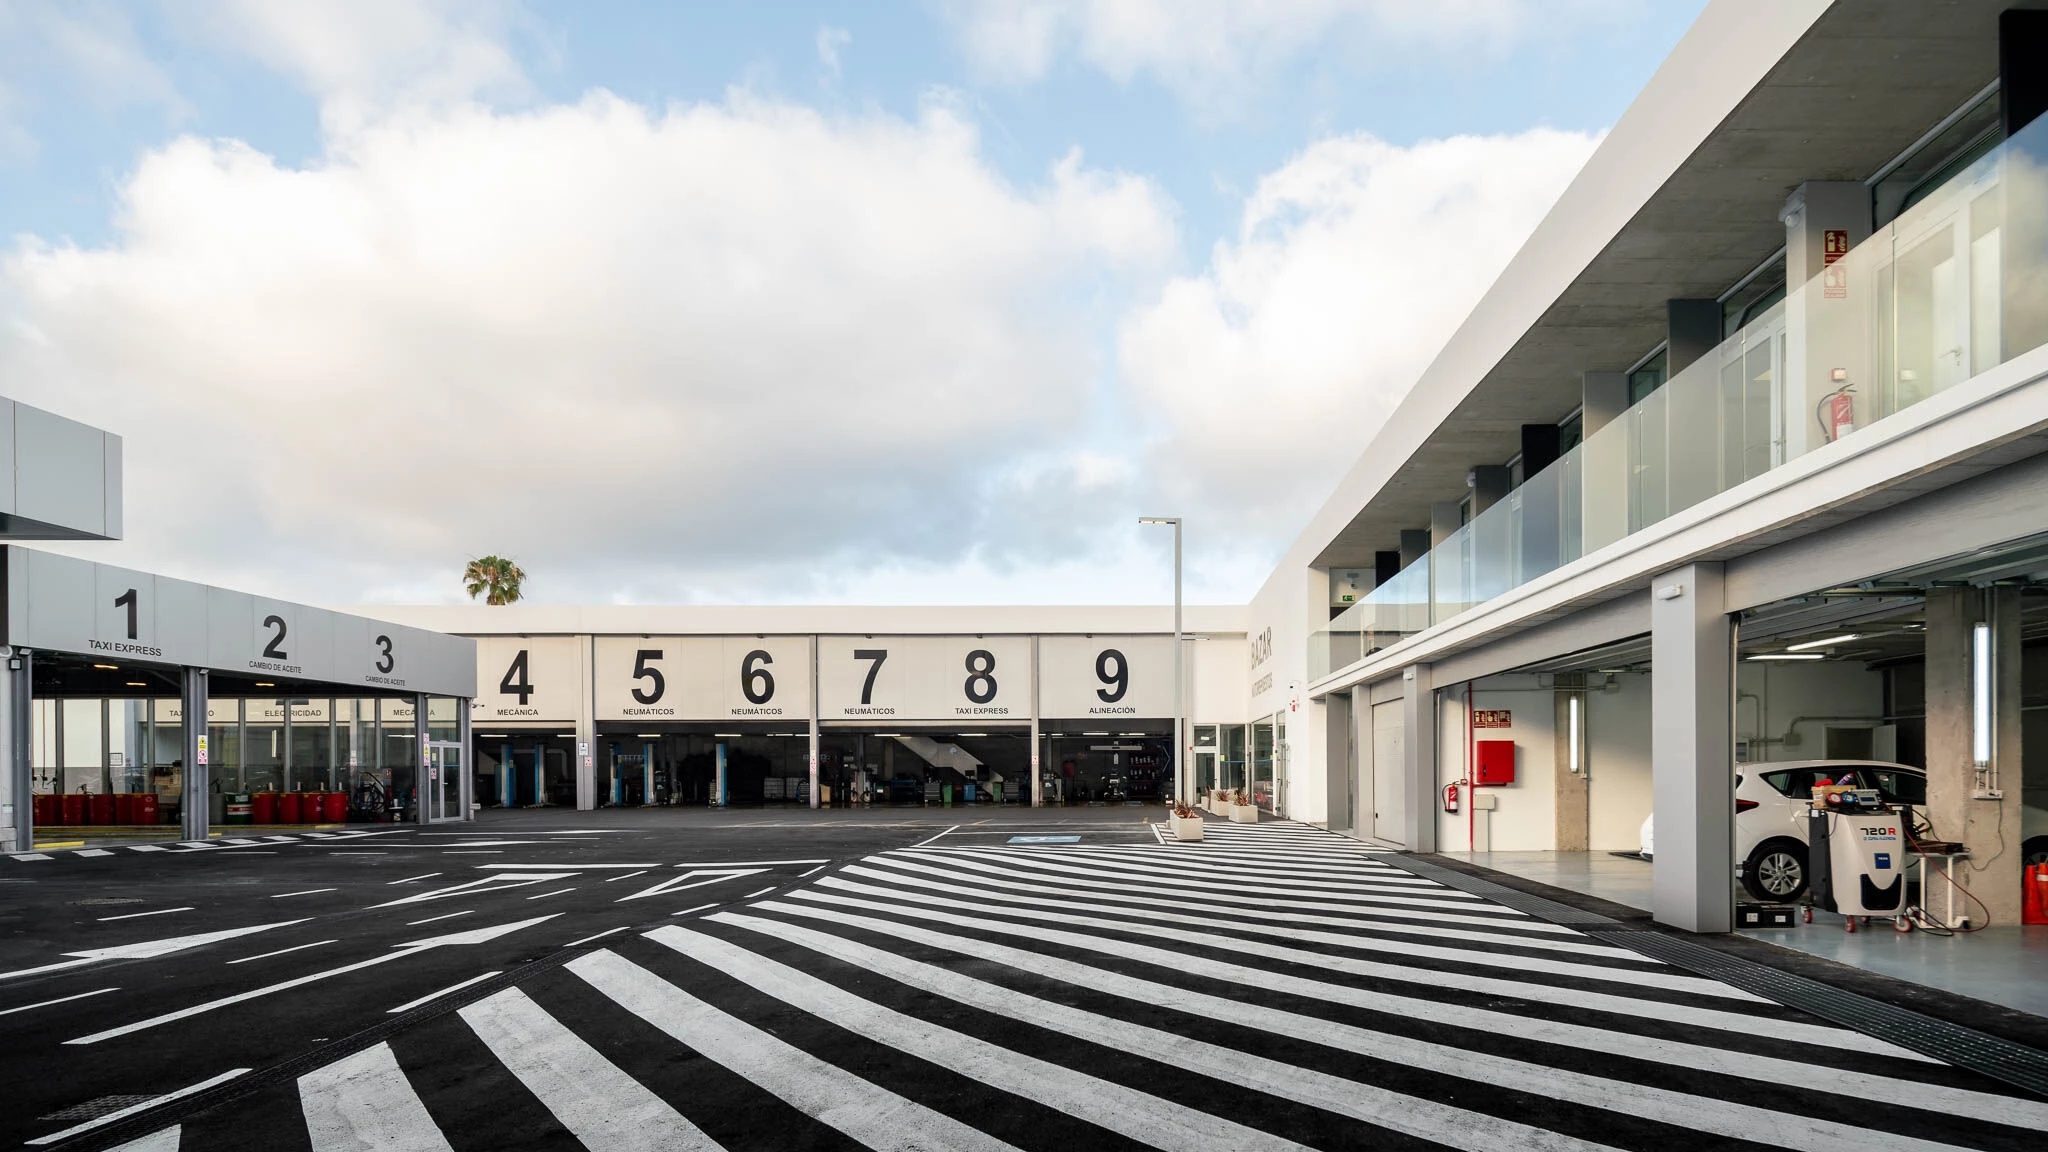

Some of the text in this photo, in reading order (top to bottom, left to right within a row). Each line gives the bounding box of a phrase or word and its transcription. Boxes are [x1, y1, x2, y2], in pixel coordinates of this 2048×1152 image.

[115, 588, 138, 640] 1
[88, 639, 162, 657] TAXI EXPRESS
[262, 614, 288, 660] 2
[375, 634, 395, 674] 3
[1251, 626, 1272, 670] BAZAR
[249, 660, 303, 674] CAMBIO DE ACEITE
[499, 649, 534, 705] 4
[631, 649, 666, 705] 5
[741, 649, 775, 705] 6
[854, 649, 888, 705] 7
[964, 649, 998, 705] 8
[1095, 648, 1129, 704] 9
[497, 708, 539, 716] MECÁNICA
[622, 707, 675, 716] NEUMÁTICOS
[731, 707, 783, 715] NEUMÁTICOS
[844, 707, 895, 715] NEUMÁTICOS
[955, 707, 1009, 715] TAXI EXPRESS
[1088, 706, 1136, 714] ALINEACIÓN
